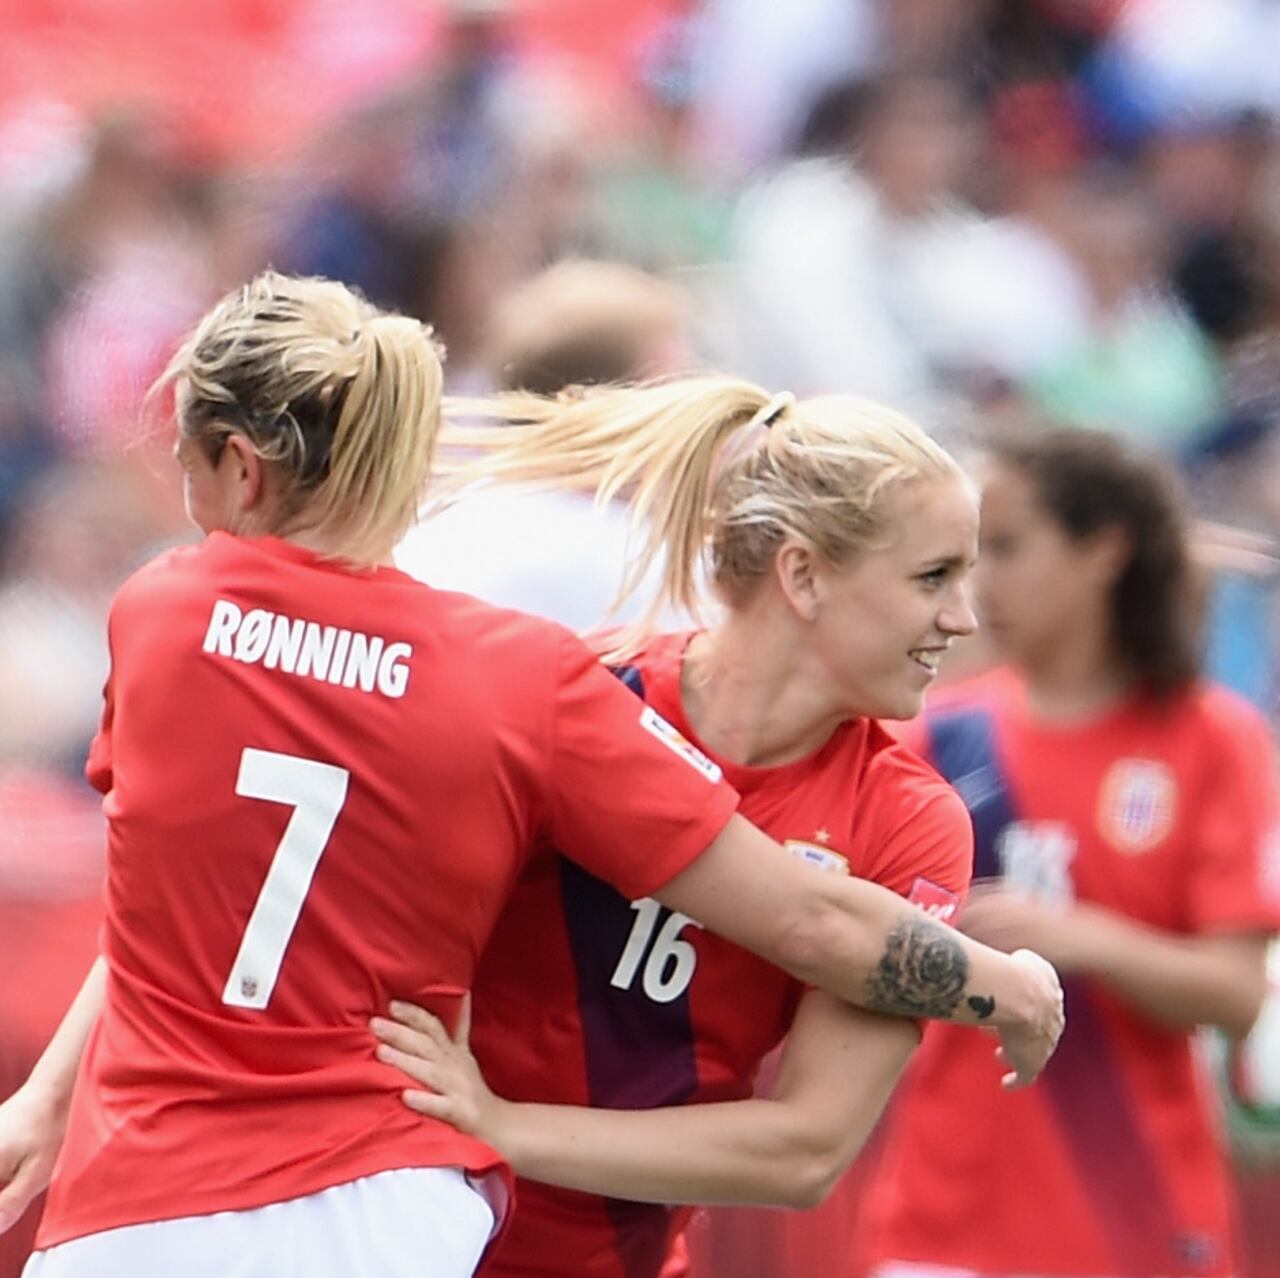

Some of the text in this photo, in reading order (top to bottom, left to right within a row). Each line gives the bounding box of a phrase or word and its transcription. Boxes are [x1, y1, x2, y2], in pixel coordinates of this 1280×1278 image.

[202, 599, 413, 698] RØNNING
[221, 747, 350, 1010] 7
[609, 897, 704, 1003] 16
